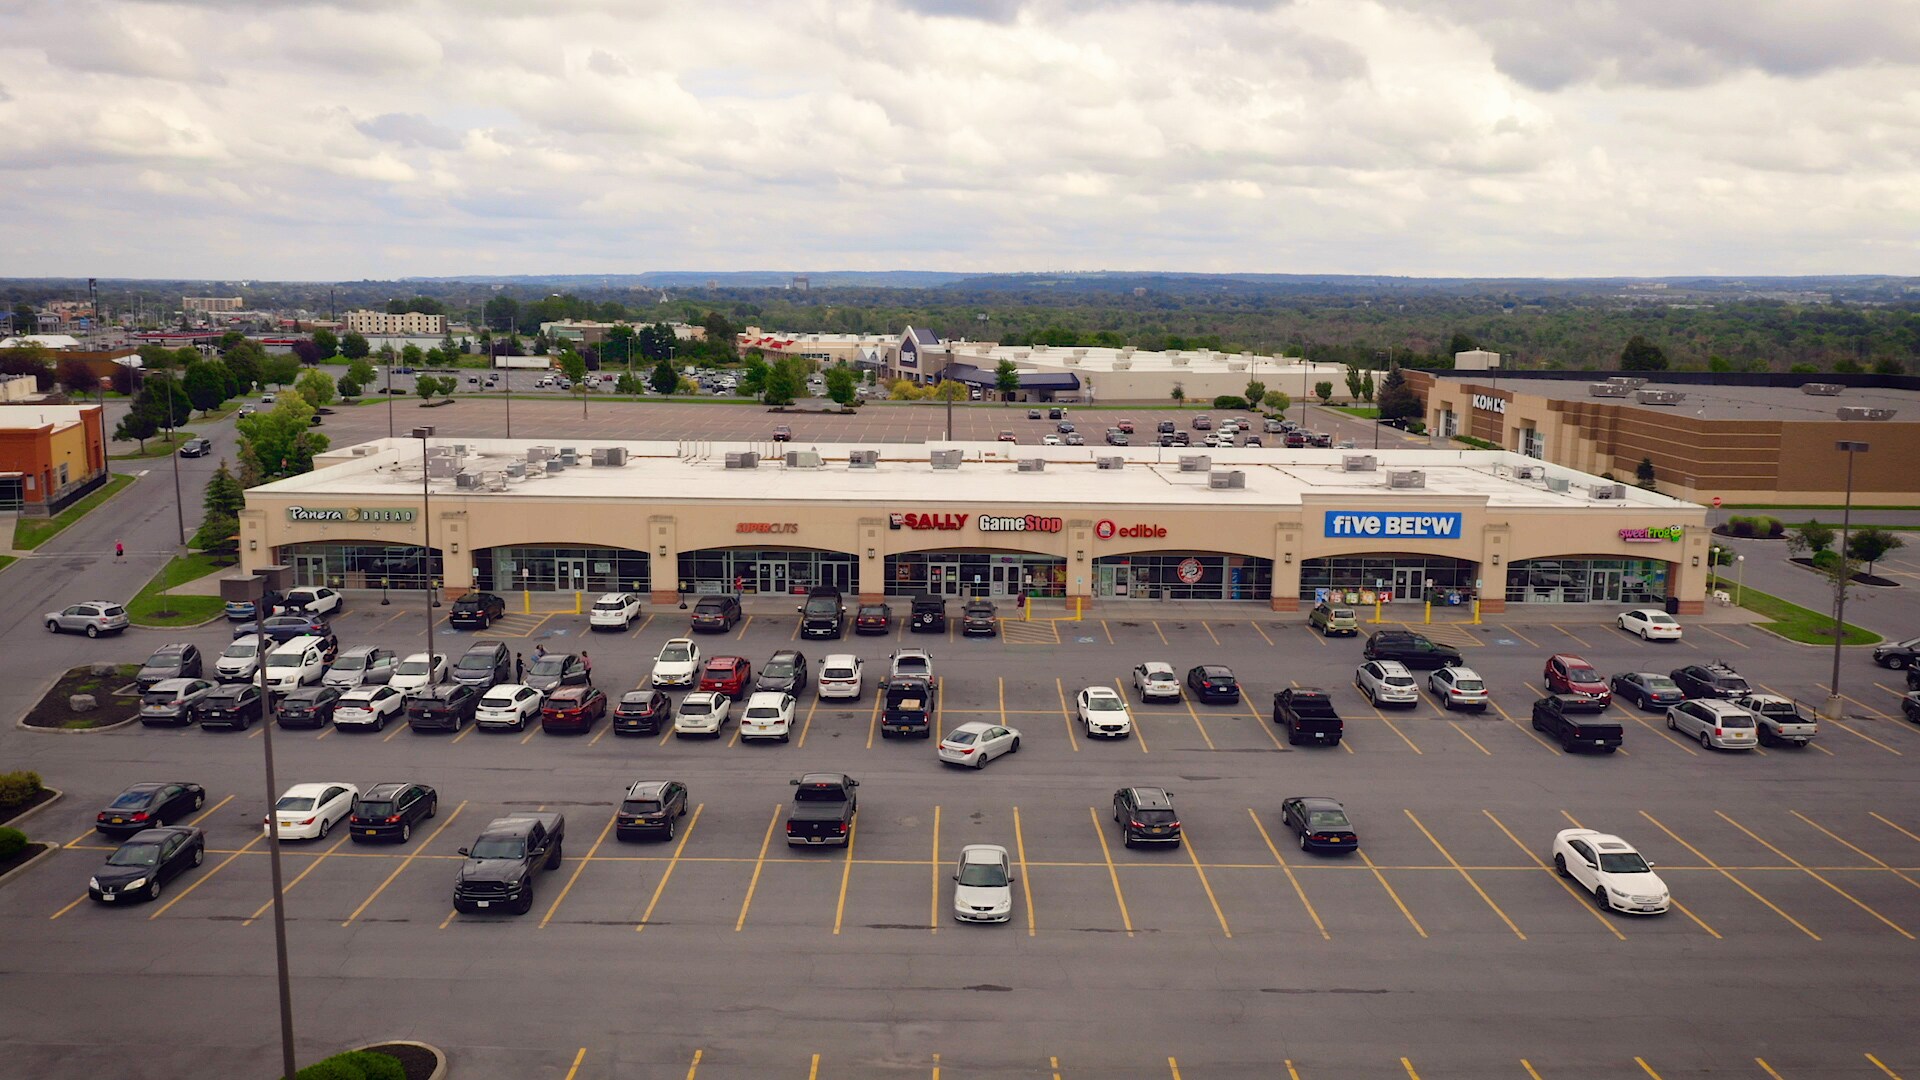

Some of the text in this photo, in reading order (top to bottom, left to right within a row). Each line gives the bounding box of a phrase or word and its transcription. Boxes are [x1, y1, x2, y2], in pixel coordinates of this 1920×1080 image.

[1472, 394, 1506, 414] KOHL'S
[289, 506, 412, 521] Panera BREAD
[904, 513, 969, 528] SALLY
[736, 522, 799, 534] SUPERCUTS
[979, 514, 1063, 534] GameStop
[1119, 524, 1168, 538] edible
